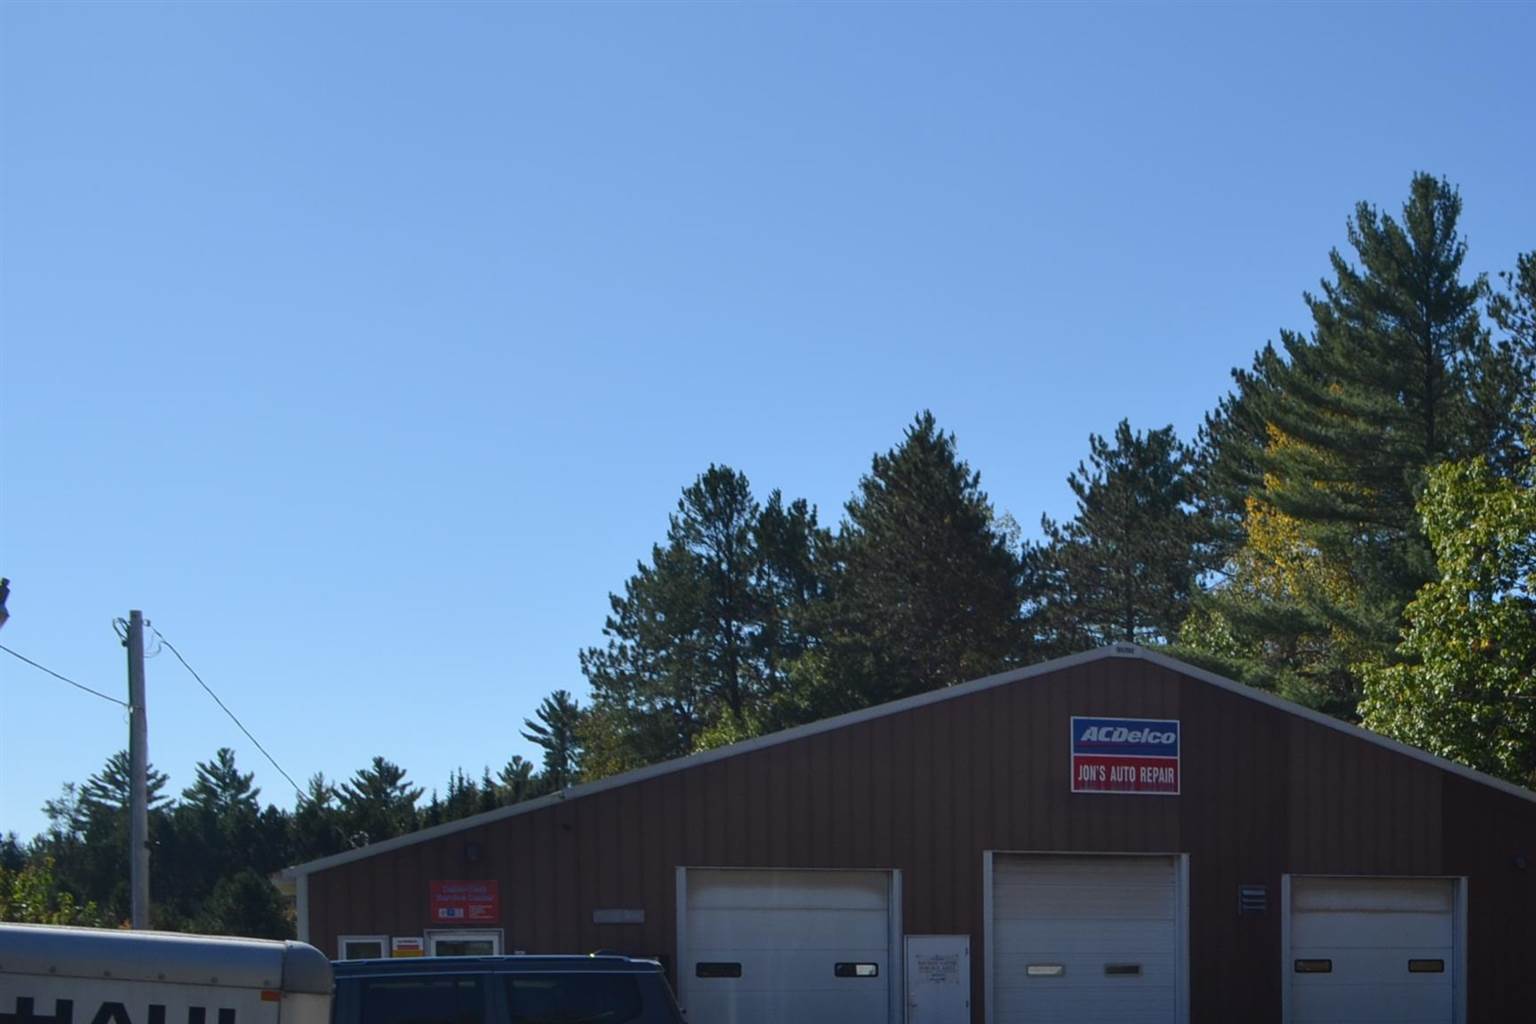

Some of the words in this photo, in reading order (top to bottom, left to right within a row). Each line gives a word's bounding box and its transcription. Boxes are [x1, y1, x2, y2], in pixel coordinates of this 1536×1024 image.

[1081, 726, 1177, 744] ACDelco
[1078, 765, 1106, 782] JON'S
[1110, 766, 1136, 783] AUTO
[1140, 767, 1175, 784] REPAIR
